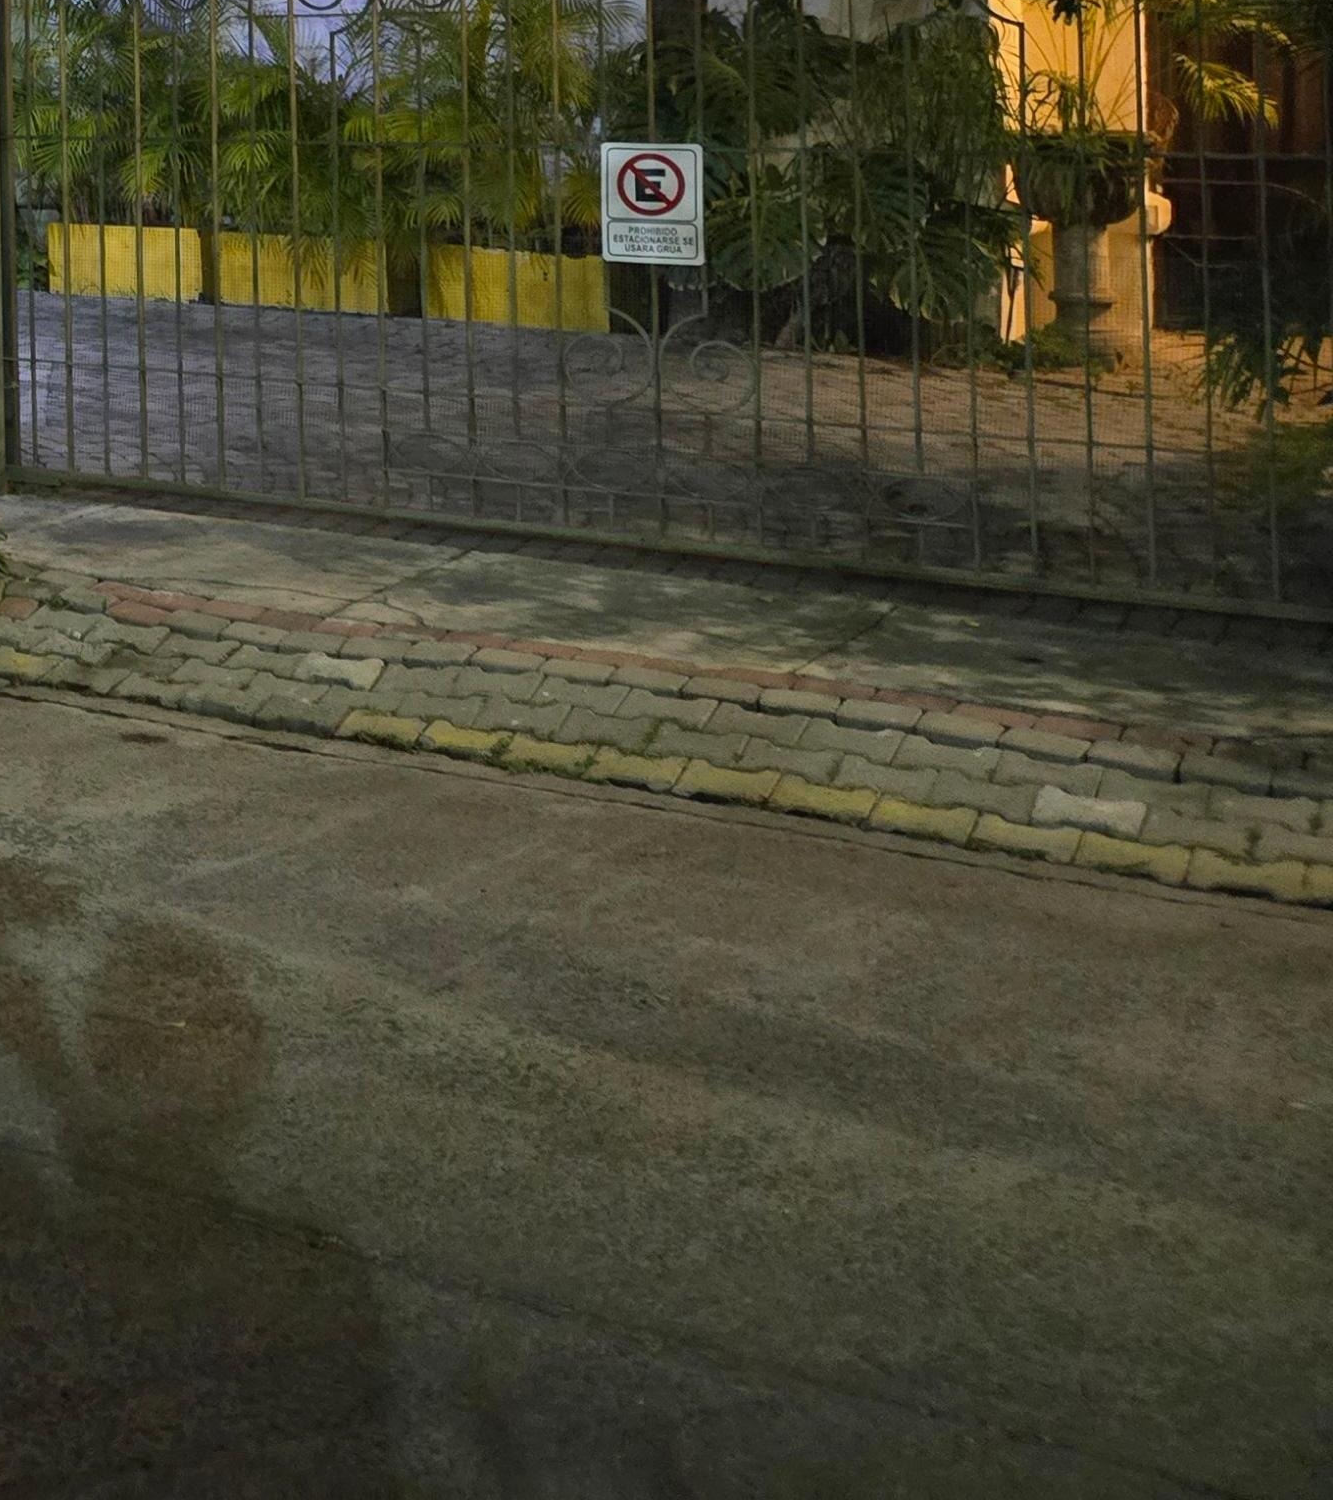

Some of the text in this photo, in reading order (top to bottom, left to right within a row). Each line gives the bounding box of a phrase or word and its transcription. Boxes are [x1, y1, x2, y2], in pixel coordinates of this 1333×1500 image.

[628, 226, 677, 236] PROHIBIDO
[613, 234, 694, 246] ESTACIONARSE SE
[624, 244, 683, 254] USARA GRUA
